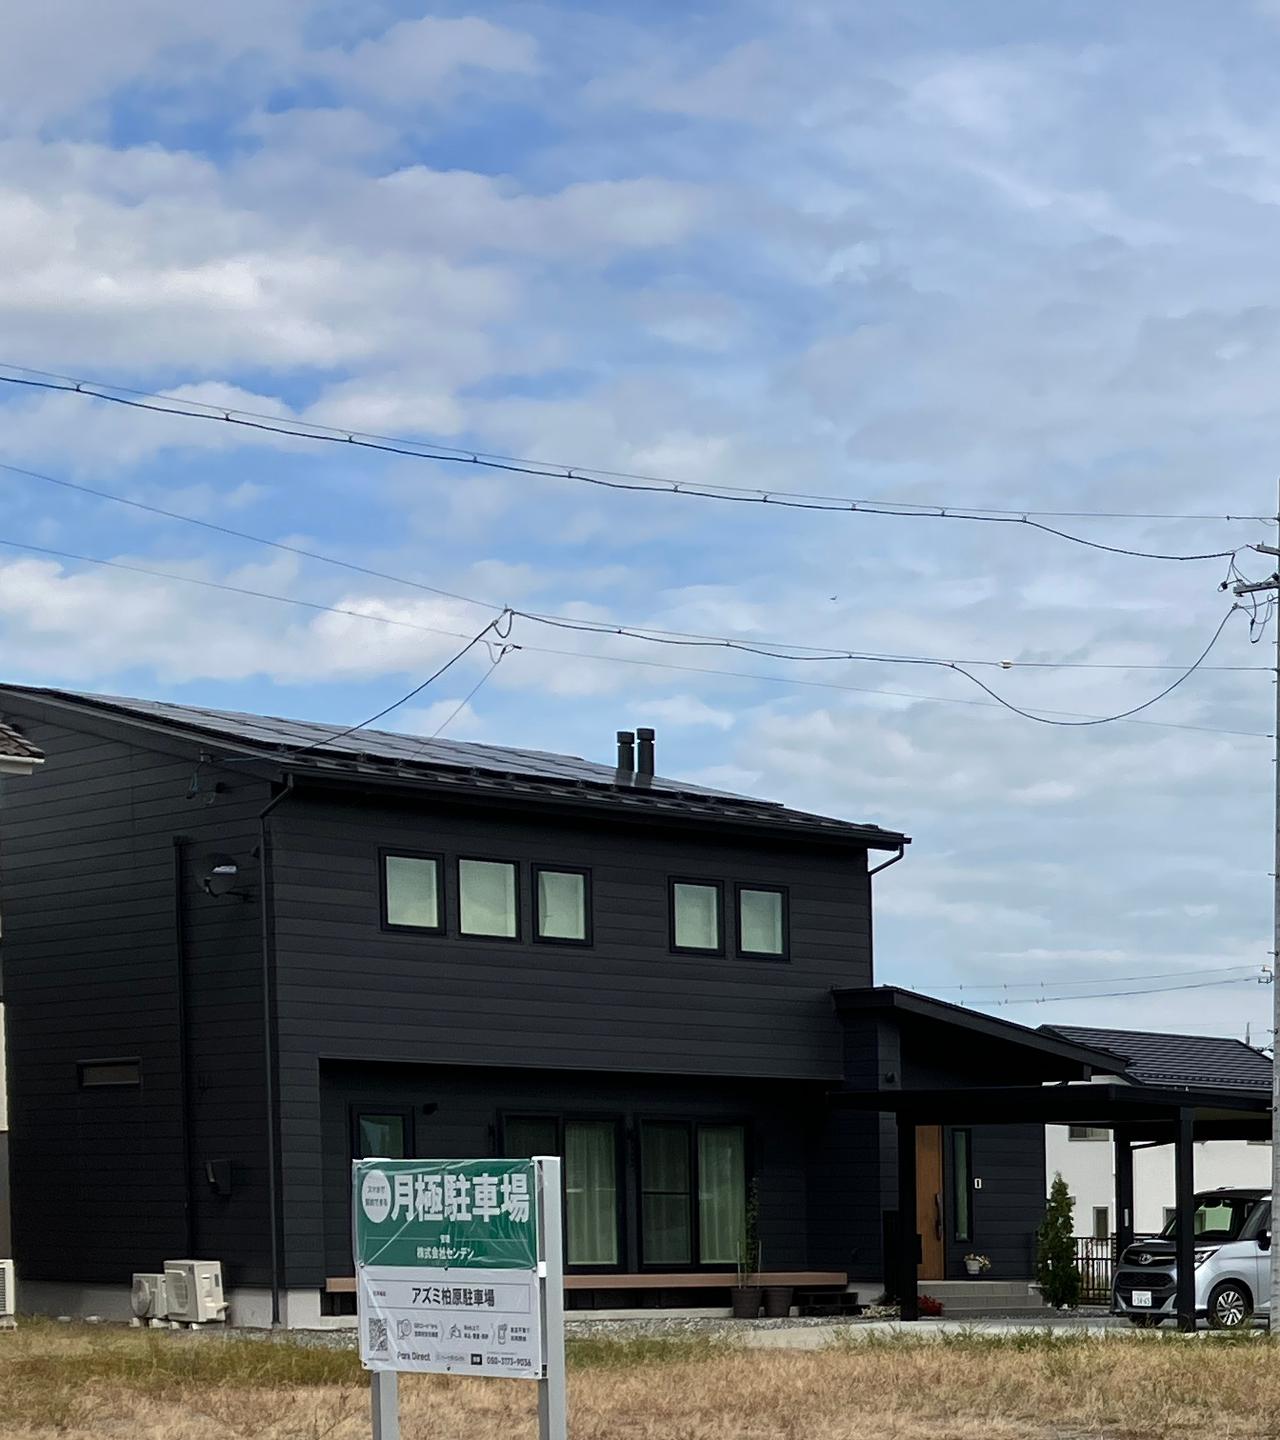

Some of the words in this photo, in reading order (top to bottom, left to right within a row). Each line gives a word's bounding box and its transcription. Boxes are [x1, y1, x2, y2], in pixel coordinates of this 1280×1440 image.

[391, 1172, 529, 1223] 月極駐車場
[416, 1247, 475, 1260] 株式会社センデン
[411, 1287, 495, 1307] アズミ柏原駐車場
[412, 1352, 431, 1361] Direct
